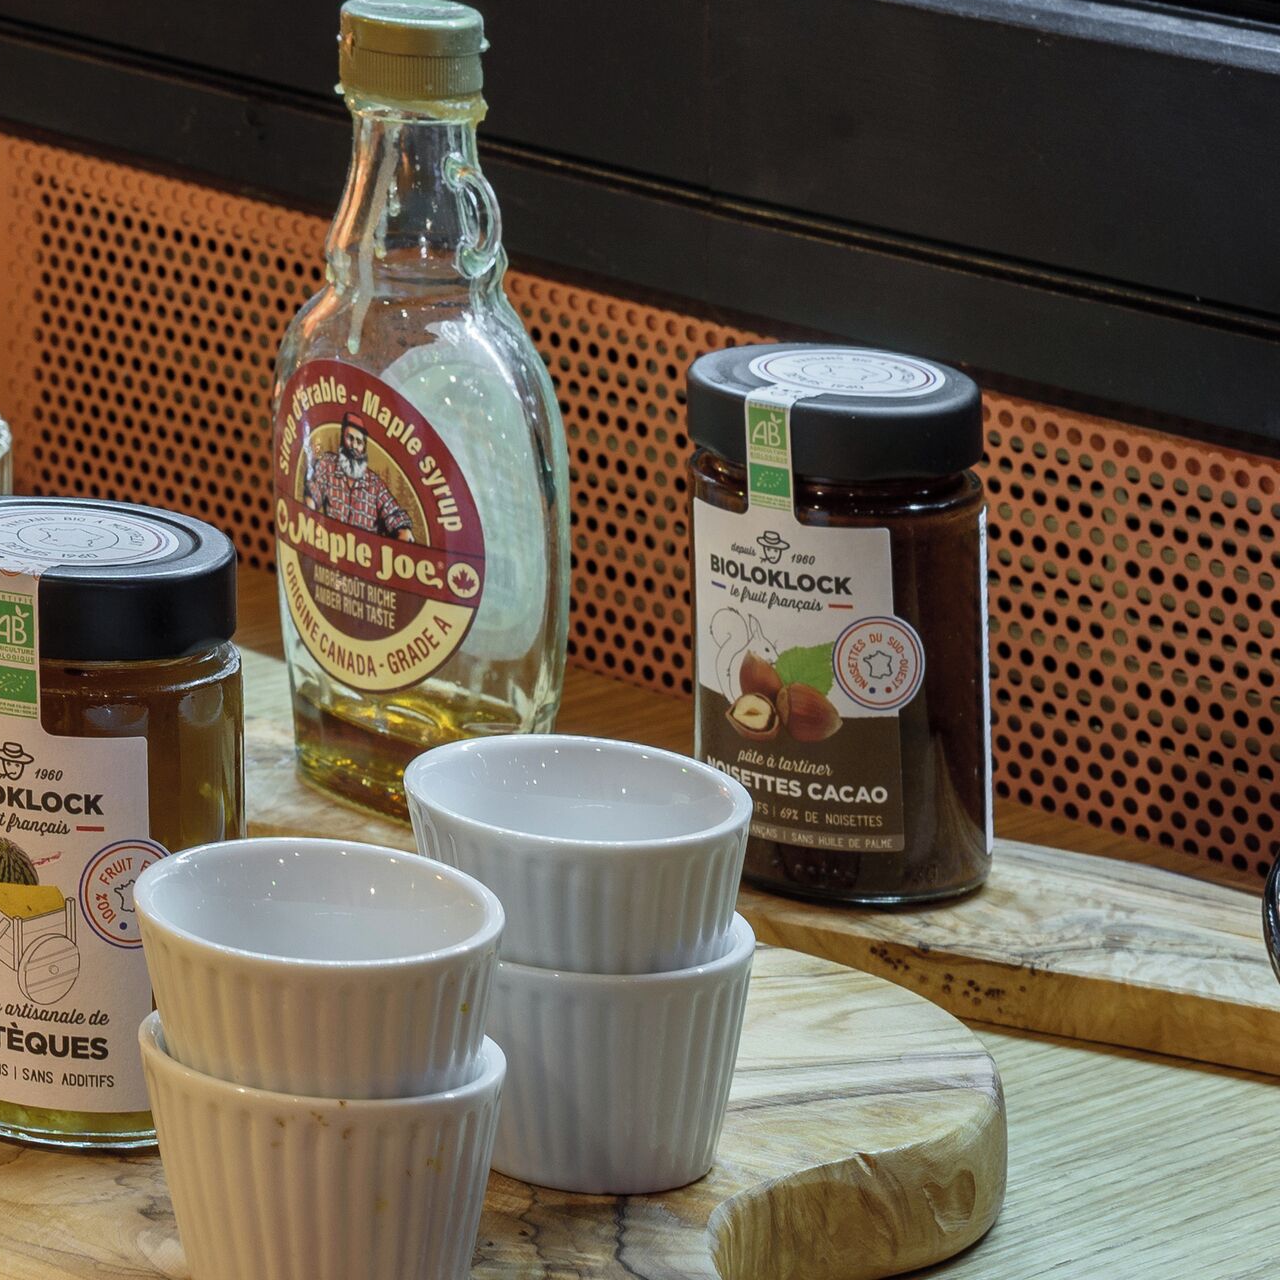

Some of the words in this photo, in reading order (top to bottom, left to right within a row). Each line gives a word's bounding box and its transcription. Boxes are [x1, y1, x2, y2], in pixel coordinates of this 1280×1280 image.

[279, 414, 298, 475] sirop
[292, 376, 347, 420] d'érable
[362, 389, 423, 455] Maple
[419, 455, 463, 532] syrup
[289, 512, 372, 568] Maple
[376, 545, 444, 590] Joe
[731, 542, 757, 557] depuis
[791, 554, 816, 566] 1960
[710, 554, 853, 596] BIOLOKLOCK
[314, 584, 341, 611] AMBER
[343, 595, 363, 620] RICH
[365, 604, 395, 630] TASTE
[367, 584, 397, 610] RICHE
[730, 584, 740, 597] le
[740, 586, 768, 604] fruit
[768, 592, 823, 613] français
[287, 562, 318, 642] ORIGINE
[320, 634, 378, 678] CANADA
[386, 628, 440, 675] GRADE
[433, 615, 452, 636] A
[847, 639, 868, 690] NOISETTES
[869, 632, 883, 644] DU
[887, 636, 909, 691] SUD-OUEST
[34, 768, 63, 781] 1960
[737, 748, 764, 766] pâte
[766, 754, 776, 768] à
[778, 756, 833, 776] tartiner
[807, 783, 888, 804] CACAO
[6, 812, 70, 836] français
[780, 806, 799, 820] 69%
[805, 811, 820, 824] DE
[826, 814, 883, 827] NOISETTES
[791, 832, 814, 844] SANS
[818, 835, 844, 848] HUILE
[849, 837, 861, 849] DE
[866, 838, 893, 849] PALME
[99, 857, 133, 885] FRUIT
[5, 1003, 86, 1025] artisanale
[88, 1009, 110, 1026] de
[22, 1068, 53, 1084] SANS
[62, 1073, 114, 1088] ADDITIFS
